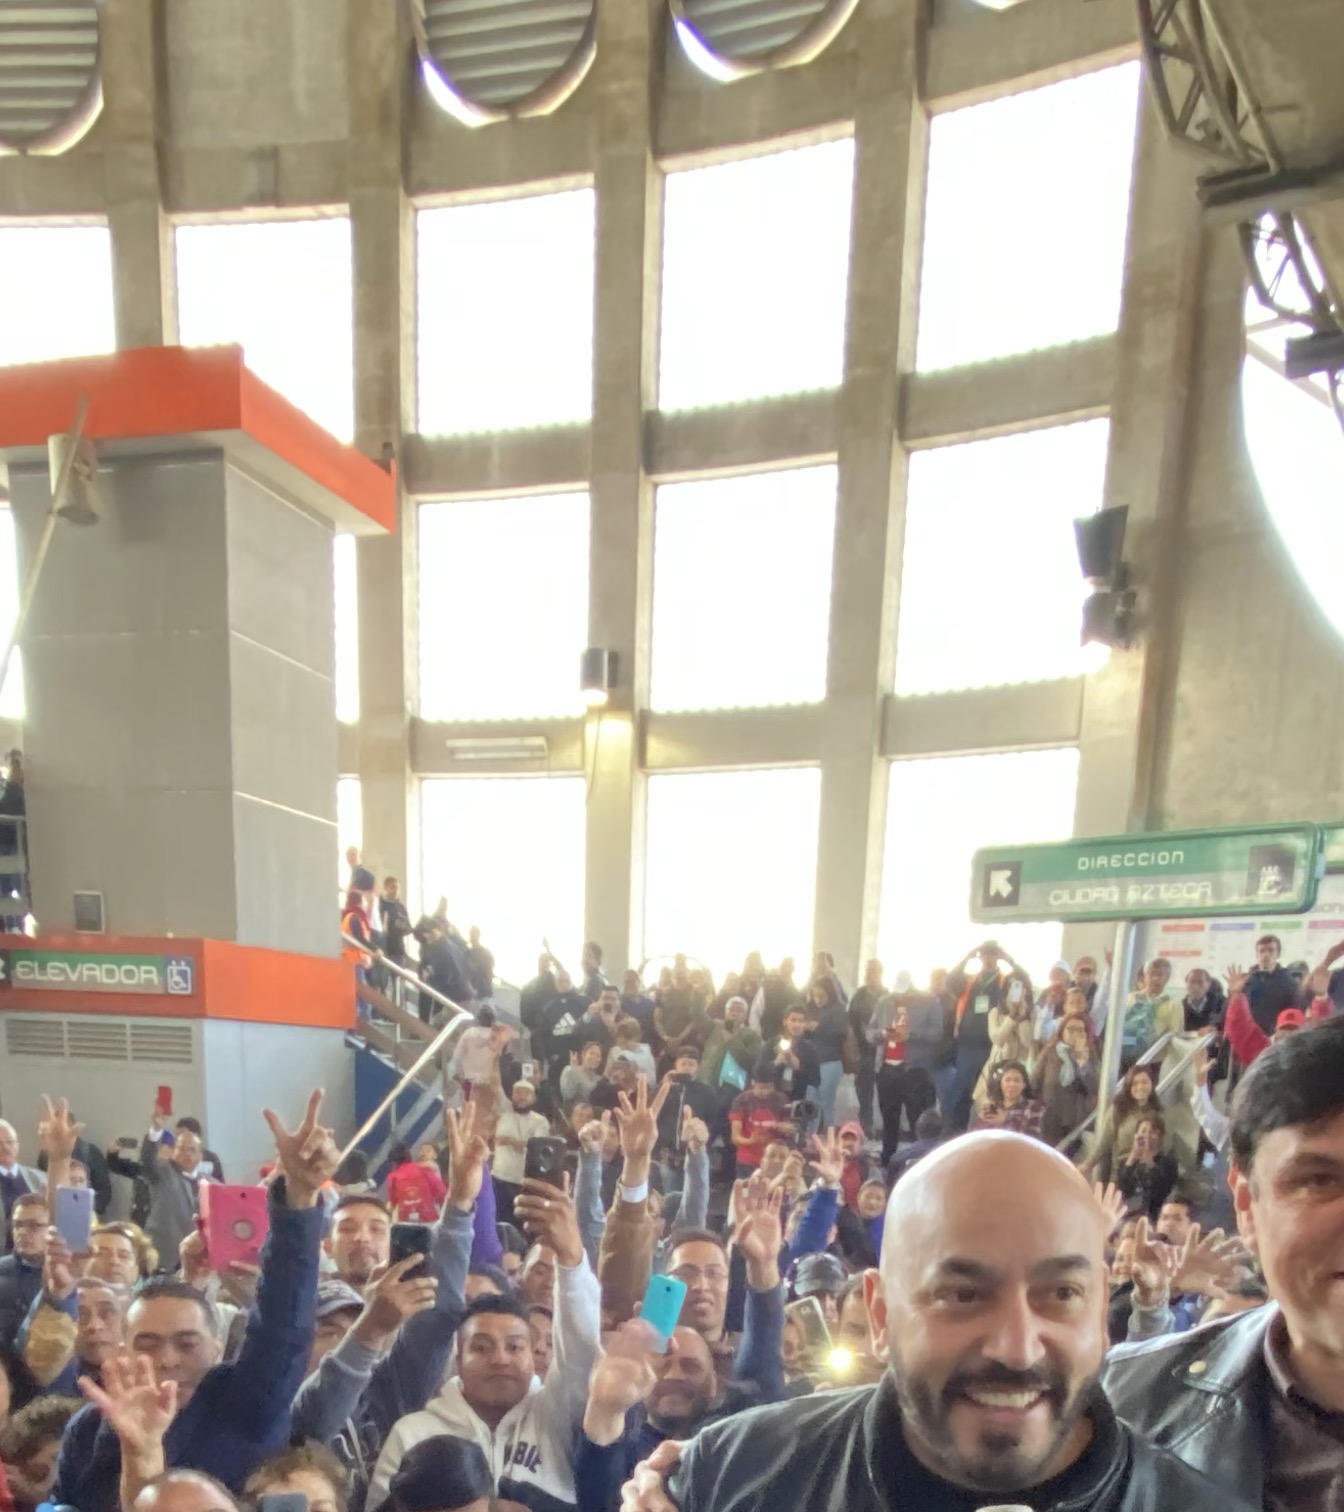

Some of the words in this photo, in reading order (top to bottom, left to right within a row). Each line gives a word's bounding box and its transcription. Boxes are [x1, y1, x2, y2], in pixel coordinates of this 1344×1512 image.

[1077, 850, 1184, 871] DIRECCION
[1049, 884, 1119, 906] CIUDAD
[1126, 881, 1212, 901] AZTECA
[15, 960, 159, 985] ELEVADOR
